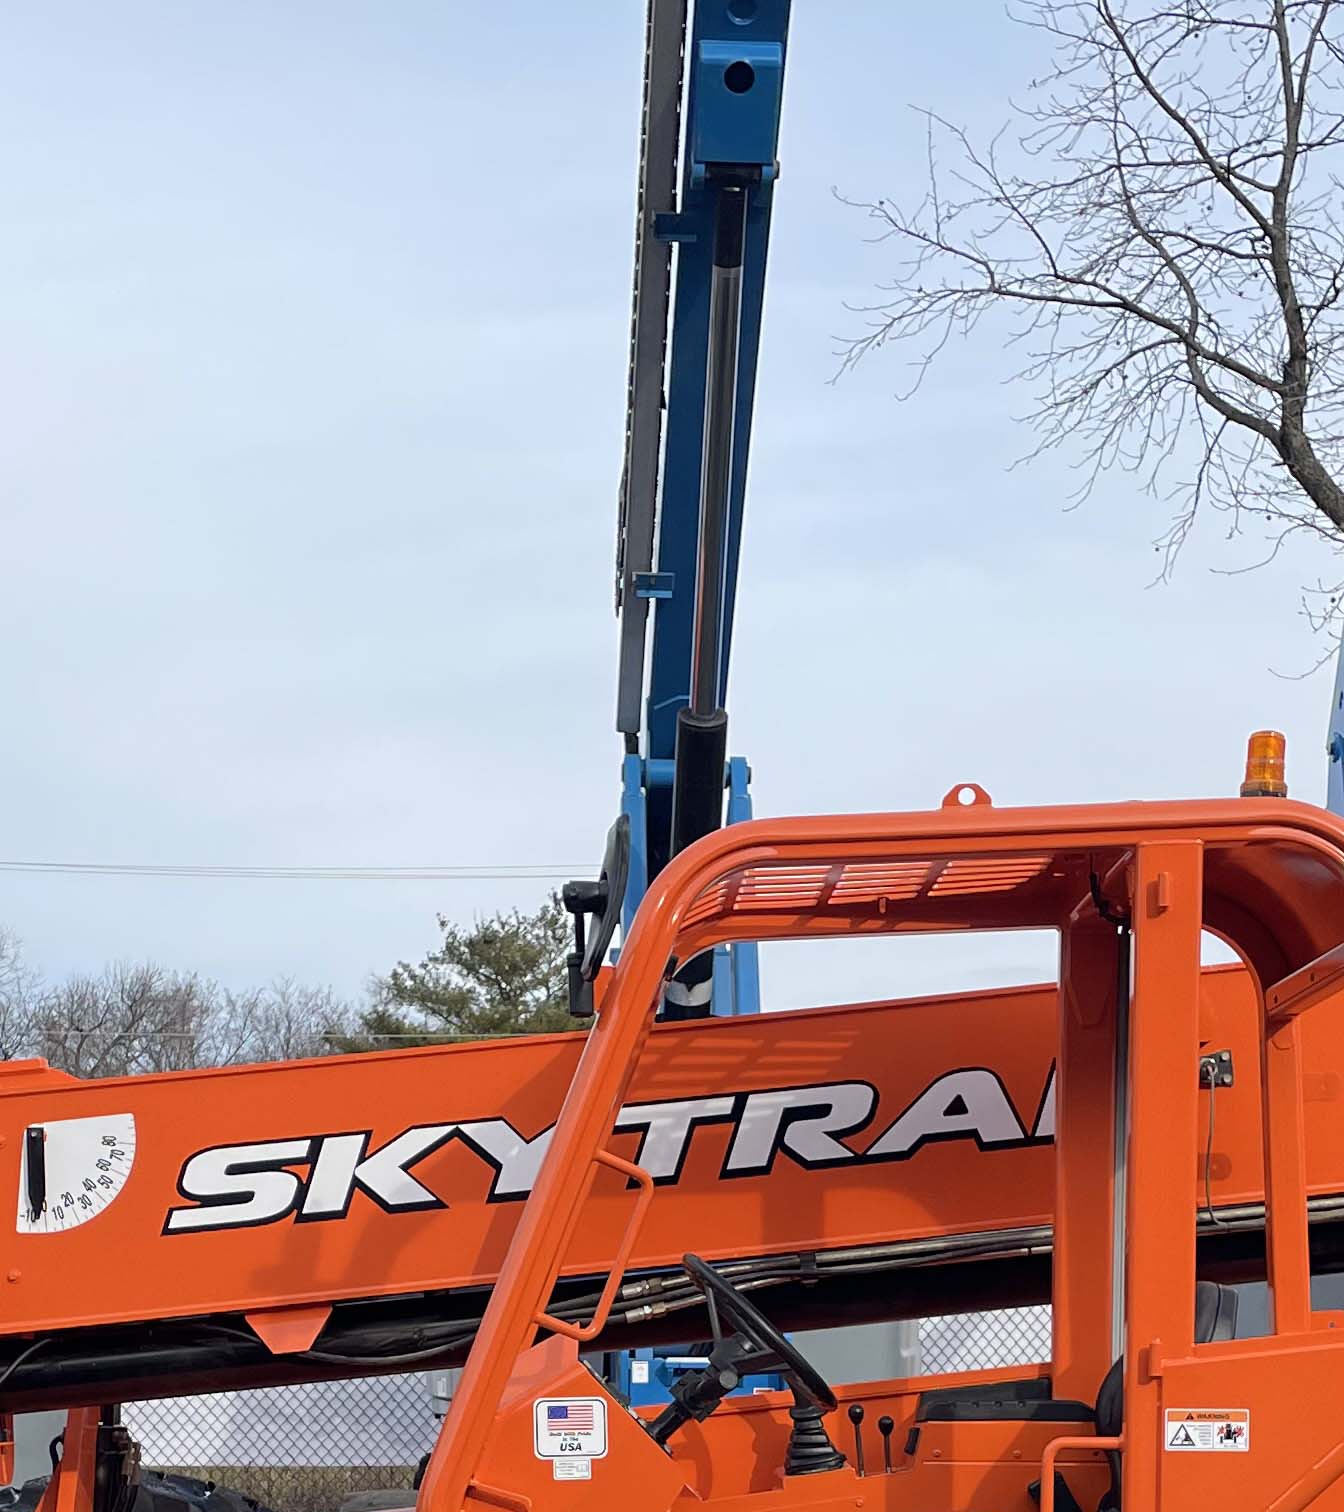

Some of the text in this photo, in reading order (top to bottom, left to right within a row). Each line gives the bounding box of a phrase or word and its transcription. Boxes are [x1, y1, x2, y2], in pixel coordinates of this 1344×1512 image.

[102, 1135, 117, 1147] 80
[161, 1058, 1056, 1236] SKYTRA
[109, 1149, 125, 1161] 70
[96, 1158, 112, 1172] 60
[82, 1178, 97, 1193] 40
[97, 1174, 114, 1190] 50
[61, 1191, 75, 1208] 20
[77, 1193, 93, 1210] 30
[52, 1205, 65, 1221] 10
[559, 1442, 582, 1452] USA
